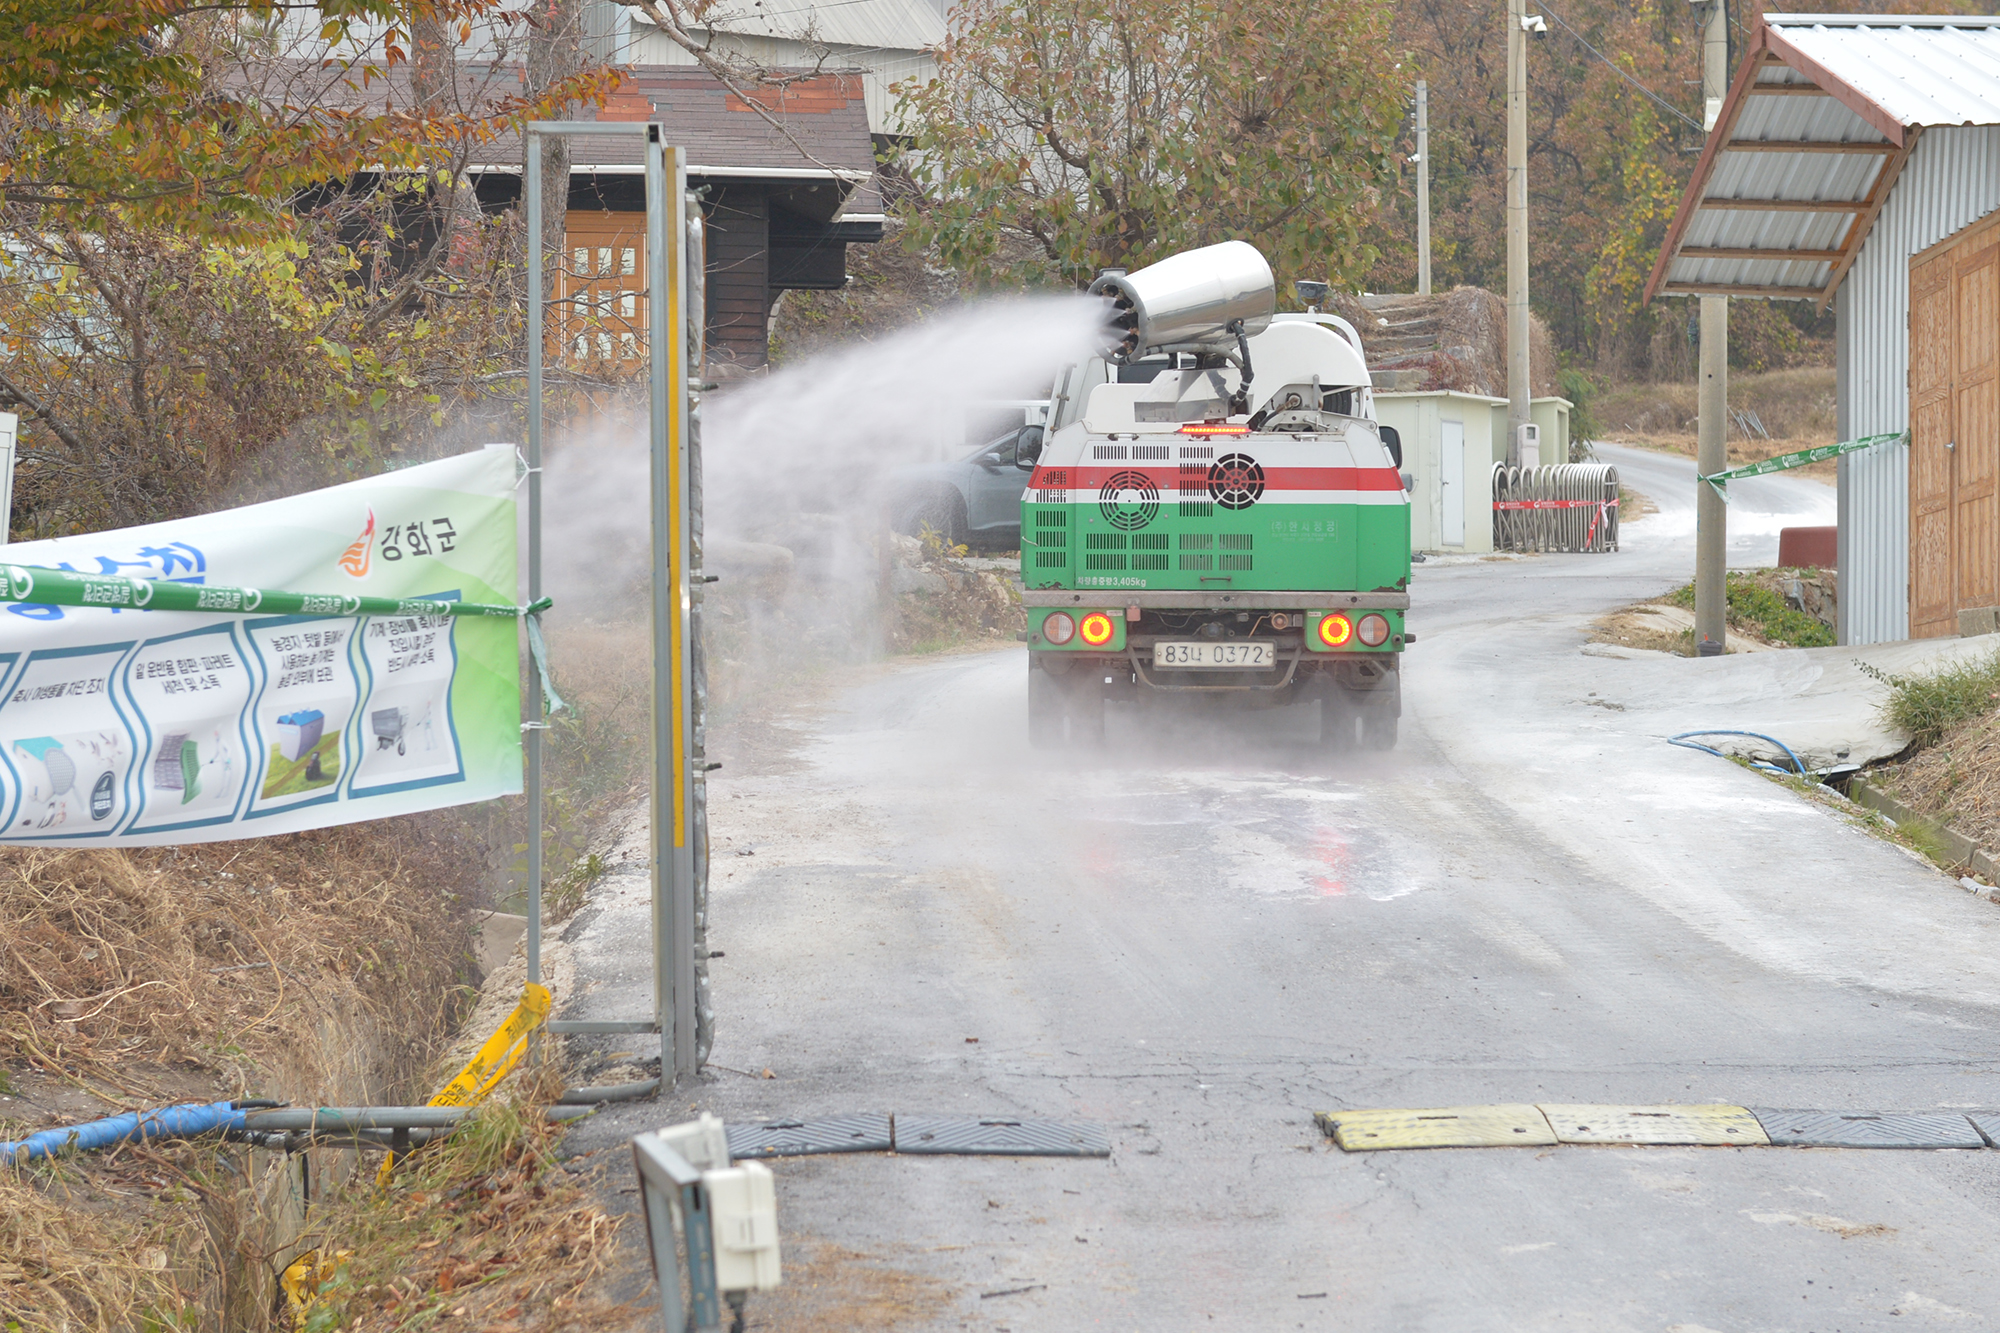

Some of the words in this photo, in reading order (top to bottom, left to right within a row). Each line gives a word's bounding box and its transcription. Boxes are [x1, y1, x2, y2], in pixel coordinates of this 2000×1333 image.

[381, 517, 457, 561] 강화군
[83, 583, 131, 604] 질병관리청
[197, 590, 241, 609] 질병관리청
[1165, 645, 1202, 663] 83나
[1213, 645, 1264, 664] 0372
[147, 660, 177, 679] 운반용
[317, 667, 333, 683] 보관
[86, 677, 106, 695] 조치
[184, 678, 199, 692] 및
[200, 674, 222, 690] 소독
